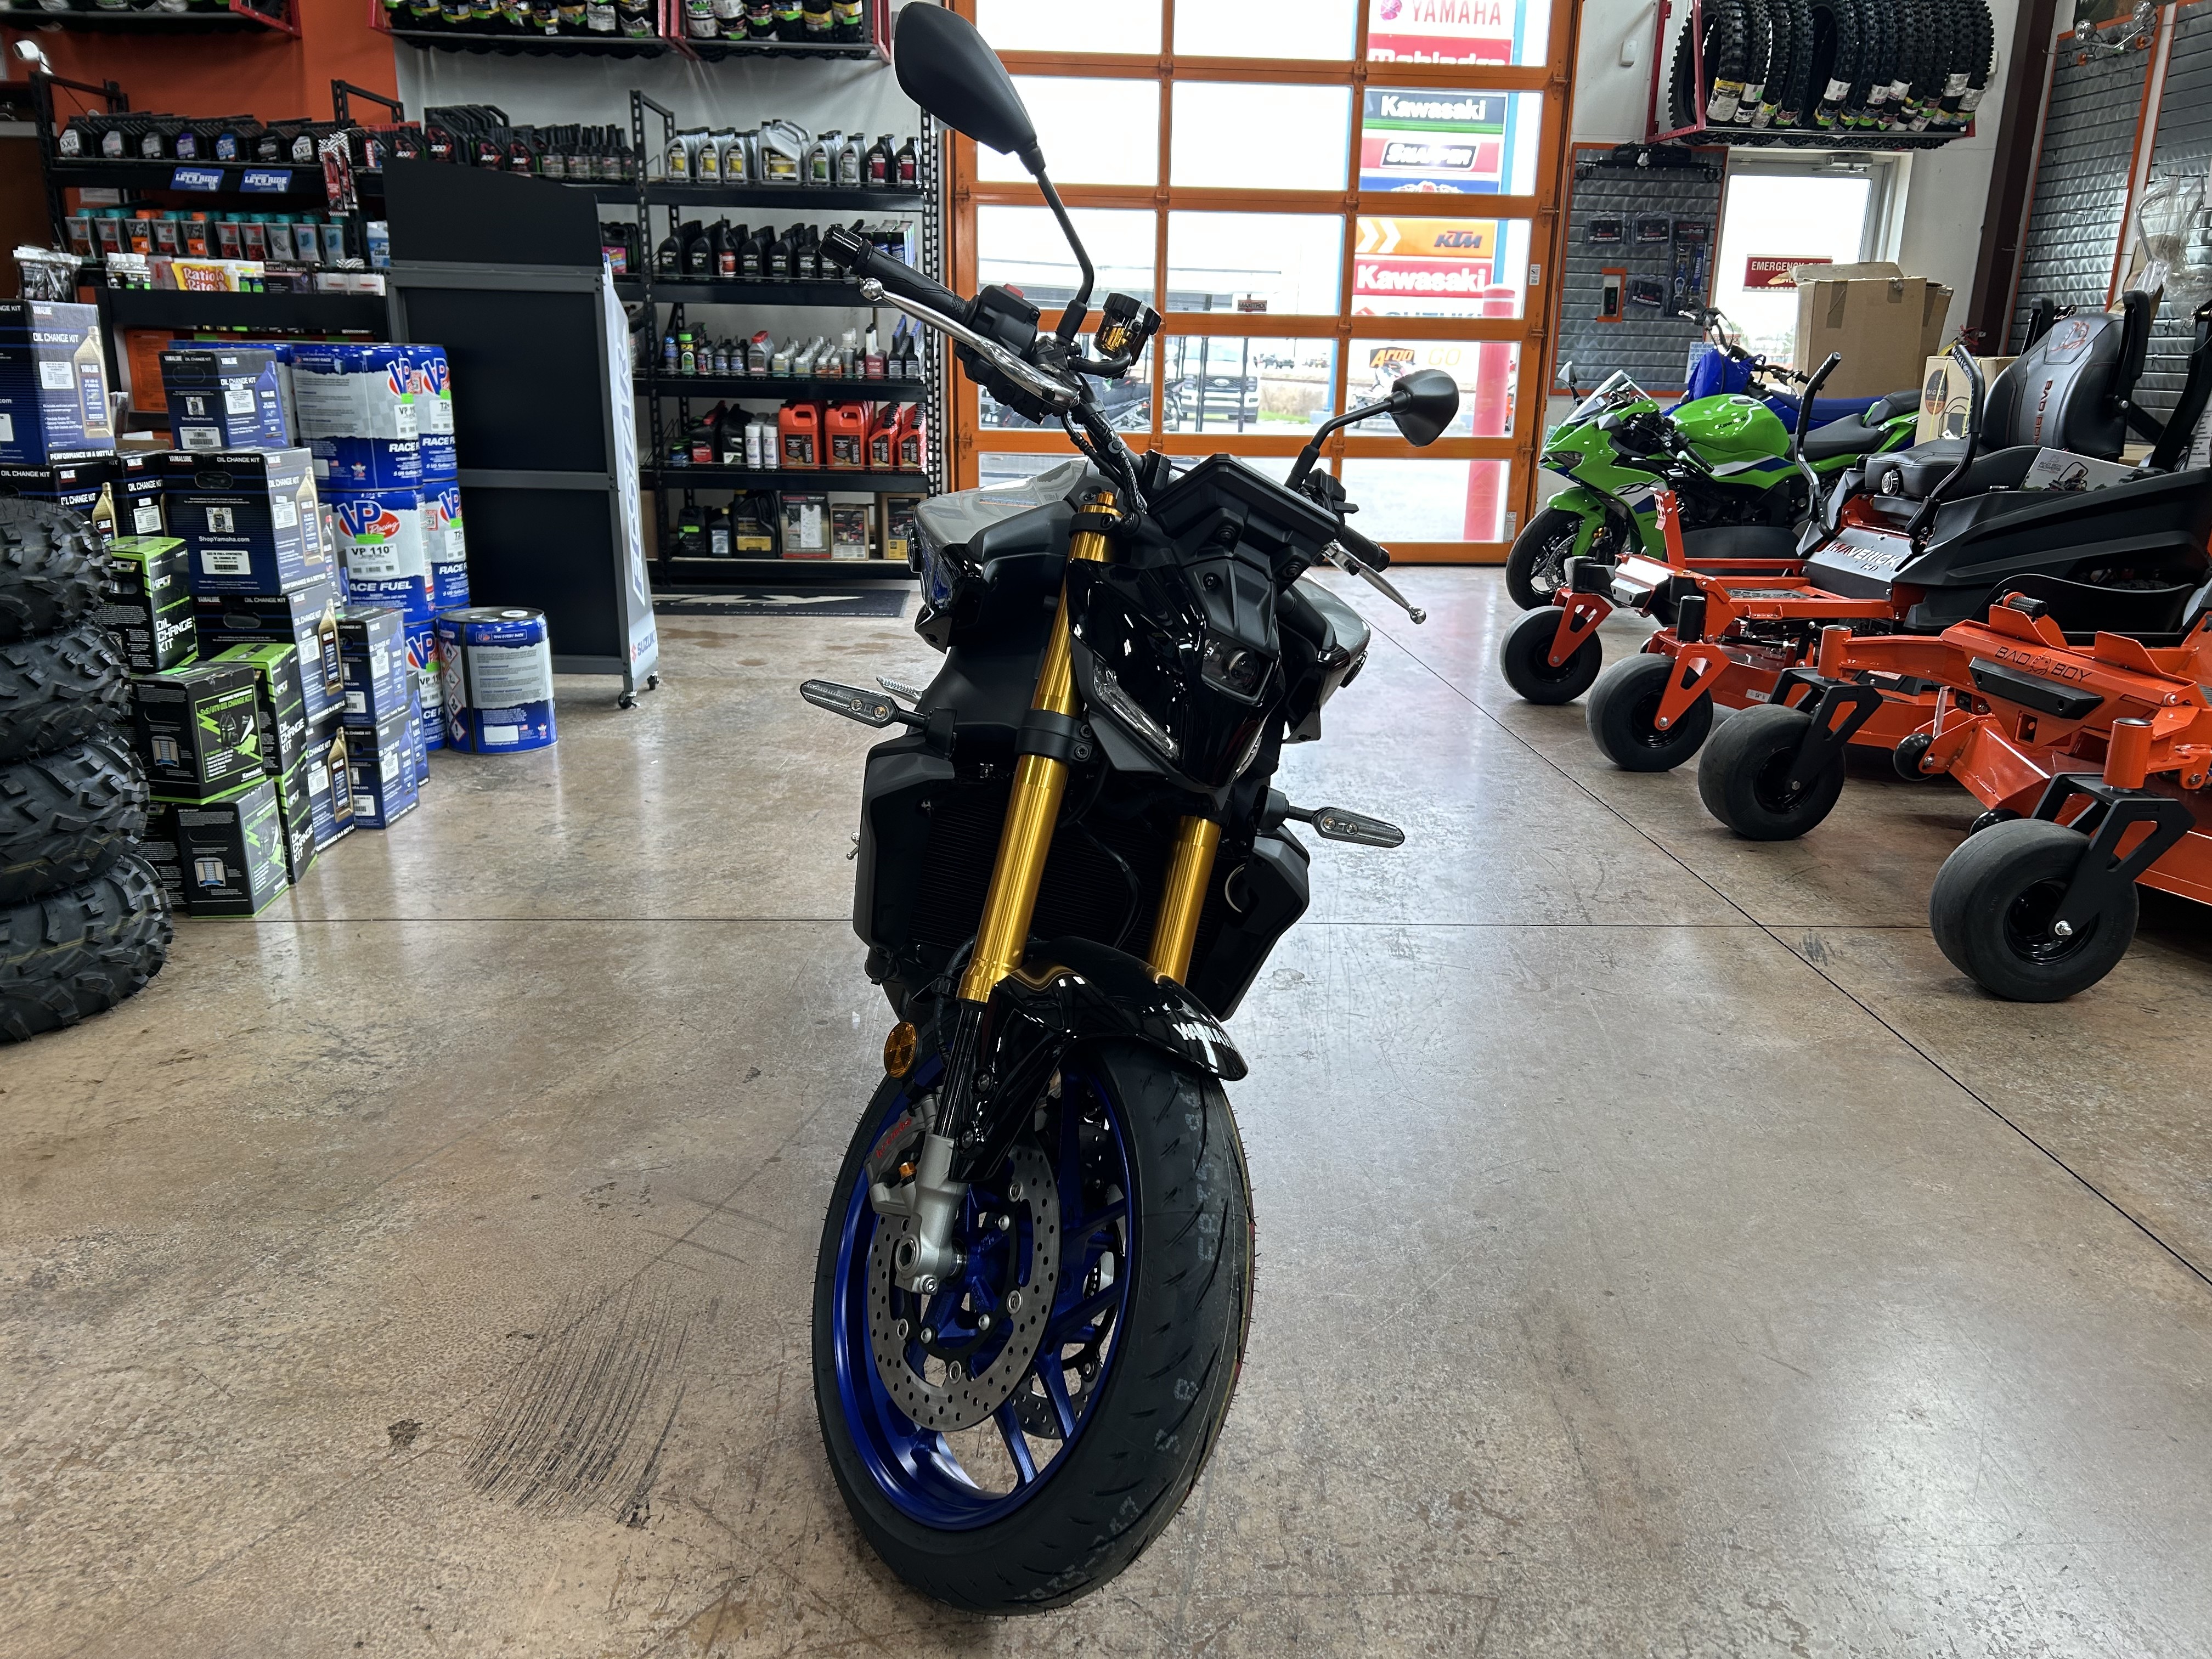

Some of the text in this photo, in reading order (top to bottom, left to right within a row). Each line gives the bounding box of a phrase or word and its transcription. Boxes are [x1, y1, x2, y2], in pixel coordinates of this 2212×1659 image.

[1413, 0, 1502, 25] YAMAHA
[1380, 95, 1487, 120] Kawasaki
[365, 139, 375, 167] MOTUL
[199, 174, 219, 183] RIDE
[1434, 229, 1482, 249] KTM
[183, 267, 215, 280] Ratio
[1356, 264, 1487, 292] Kawasaki
[33, 332, 79, 343] OIL CHANGE KIT
[421, 358, 448, 396] VP
[2033, 380, 2053, 446] BAD BOY
[388, 442, 416, 453] RACE
[422, 436, 449, 446] RACE
[49, 450, 86, 460] PERFORMANCE
[128, 483, 137, 492] OIL
[137, 481, 156, 490] CHANGE
[69, 494, 88, 506] CHANGE
[88, 493, 96, 501] KIT
[438, 487, 461, 519] VP
[336, 500, 382, 538] VP
[369, 521, 400, 534] Racing
[351, 545, 390, 556] VP 110
[1826, 541, 1903, 567] MAVERICK
[438, 563, 464, 575] RACE
[1860, 563, 1879, 572] HD
[349, 580, 413, 592] ACE FUEL
[156, 617, 172, 632] OIL
[156, 617, 193, 642] CHANGE
[158, 637, 174, 653] KIT
[405, 631, 435, 669] VP
[1994, 646, 2092, 682] BAD BOY
[419, 677, 431, 686] VP
[422, 708, 437, 720] CE
[279, 720, 290, 734] OIL
[280, 717, 305, 744] CHANGE
[281, 740, 294, 755] KIT
[291, 829, 301, 845] OIL
[292, 823, 314, 854] CHANGE
[294, 850, 304, 865] KIT
[1172, 1022, 1235, 1051] YAMAH
[876, 1117, 912, 1159] brembo
